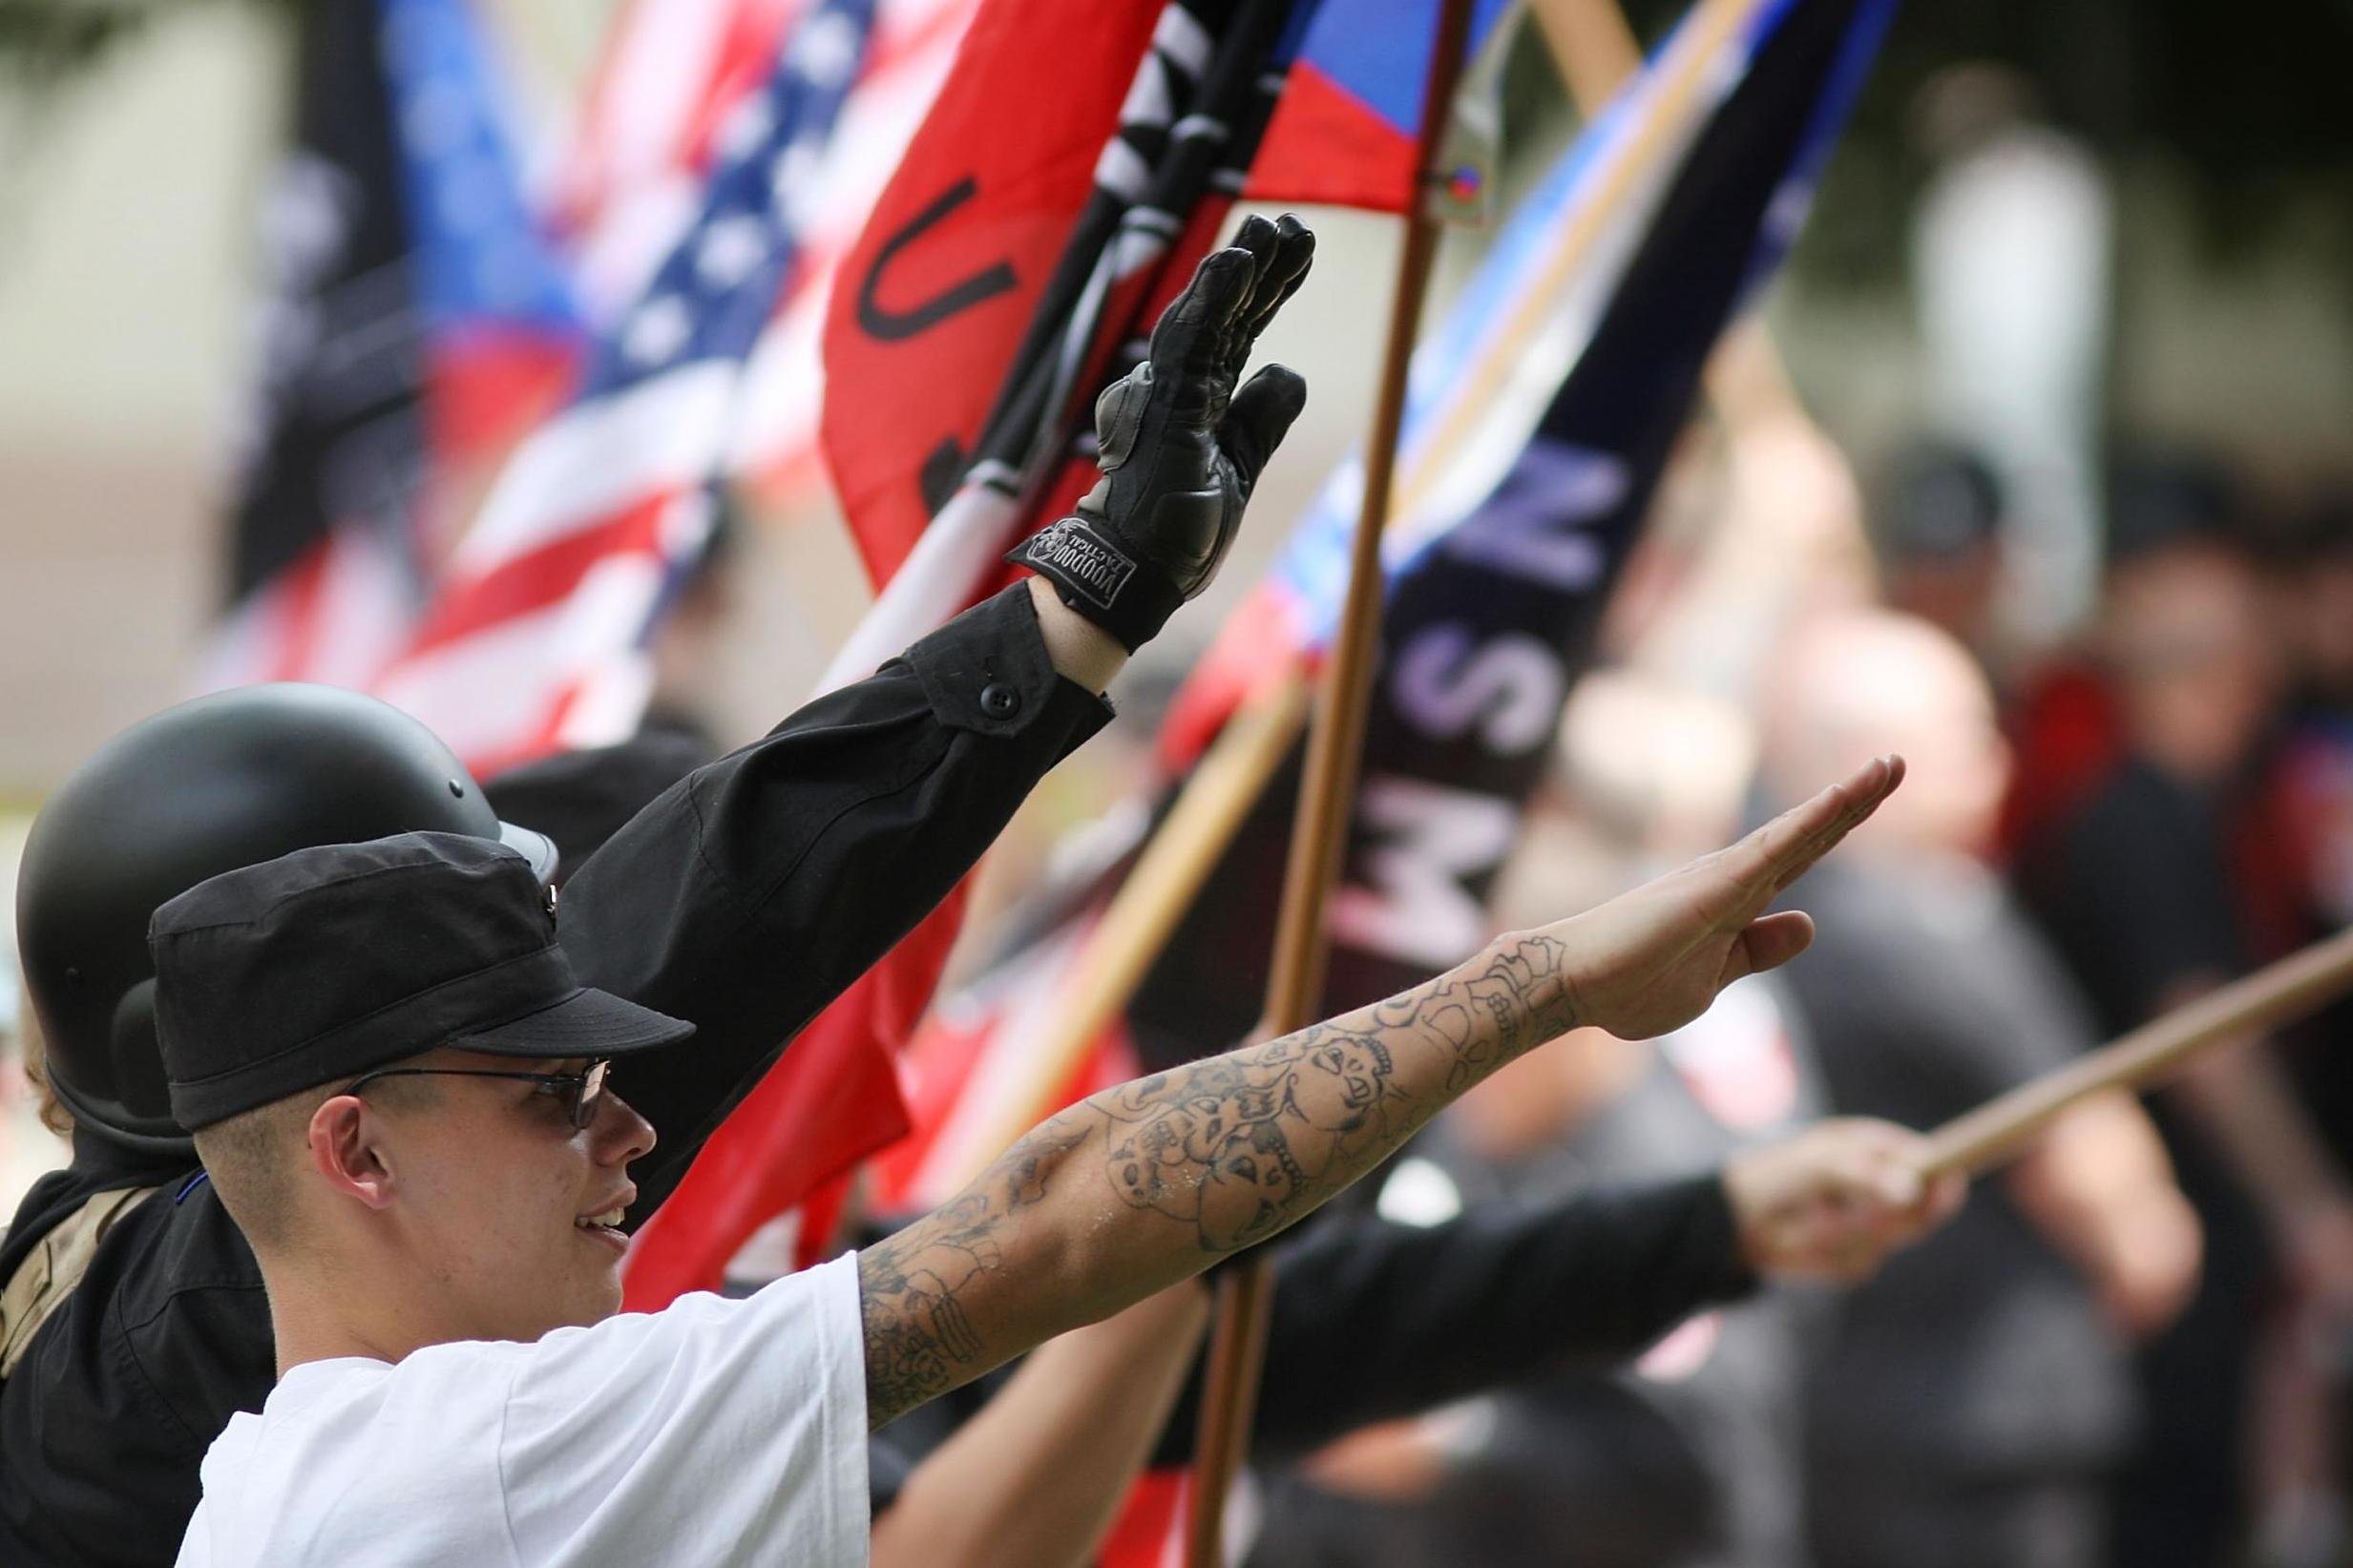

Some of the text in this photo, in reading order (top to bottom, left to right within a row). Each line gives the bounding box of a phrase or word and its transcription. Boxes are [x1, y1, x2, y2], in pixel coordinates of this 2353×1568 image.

[1053, 545, 1116, 596] VOODOO
[1068, 534, 1126, 574] TACTICAL
[1329, 437, 1627, 962] NSM
